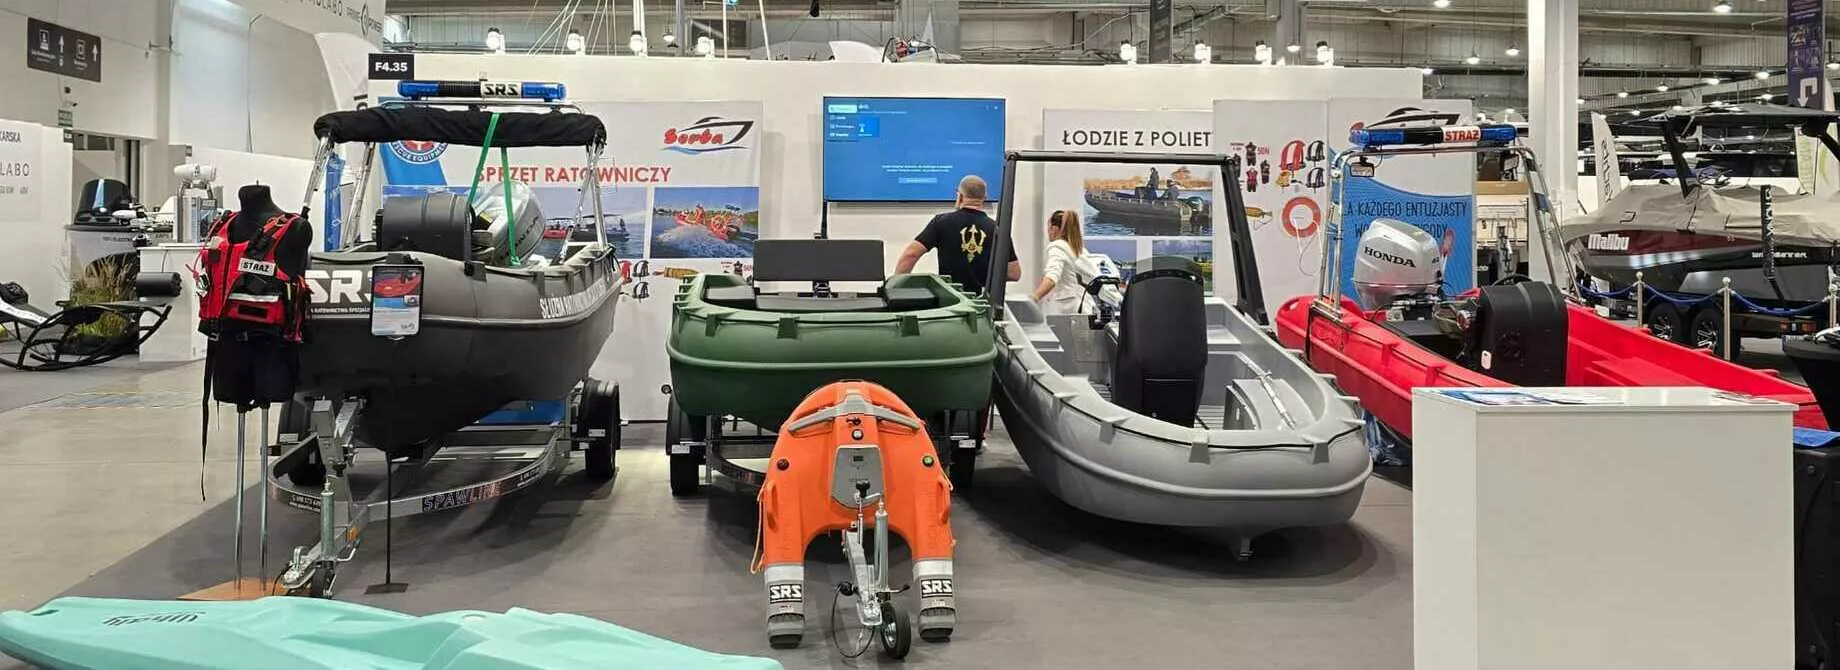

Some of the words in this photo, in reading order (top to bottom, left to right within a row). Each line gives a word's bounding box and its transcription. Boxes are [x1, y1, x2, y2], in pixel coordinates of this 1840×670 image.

[374, 62, 408, 73] F4.35
[483, 83, 520, 96] SRS
[1062, 130, 1128, 146] ŁODZIE
[1134, 131, 1144, 146] Z
[545, 166, 672, 183] RATOWNICZY
[1406, 201, 1467, 217] ENTUZJASTY
[1587, 233, 1630, 250] Malibu
[1364, 247, 1417, 268] HONDA
[304, 269, 372, 304] SR
[770, 585, 803, 600] SRS
[921, 580, 953, 594] SRS
